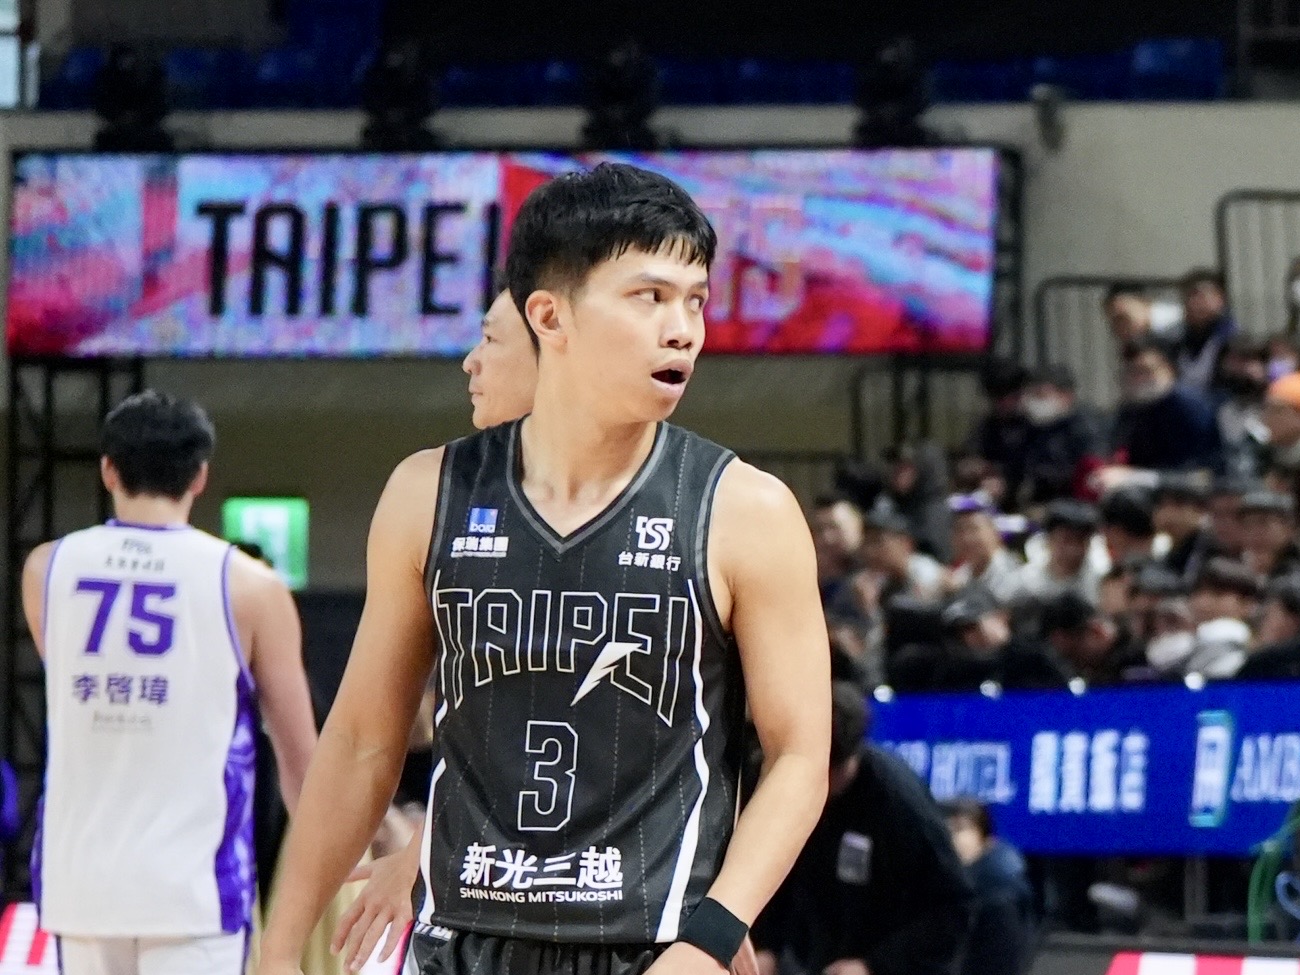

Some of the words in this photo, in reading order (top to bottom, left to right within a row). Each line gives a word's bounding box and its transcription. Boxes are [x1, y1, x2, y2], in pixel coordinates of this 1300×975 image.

[197, 201, 500, 316] TAIPEI
[618, 551, 681, 571] 台新銀行
[76, 579, 177, 656] 75
[436, 588, 688, 727] TAIPEI
[517, 720, 579, 832] 3
[459, 842, 624, 889] 新光三越
[459, 887, 489, 900] SHIN
[489, 890, 526, 903] KONG
[528, 889, 623, 903] MITSUKOSHI
